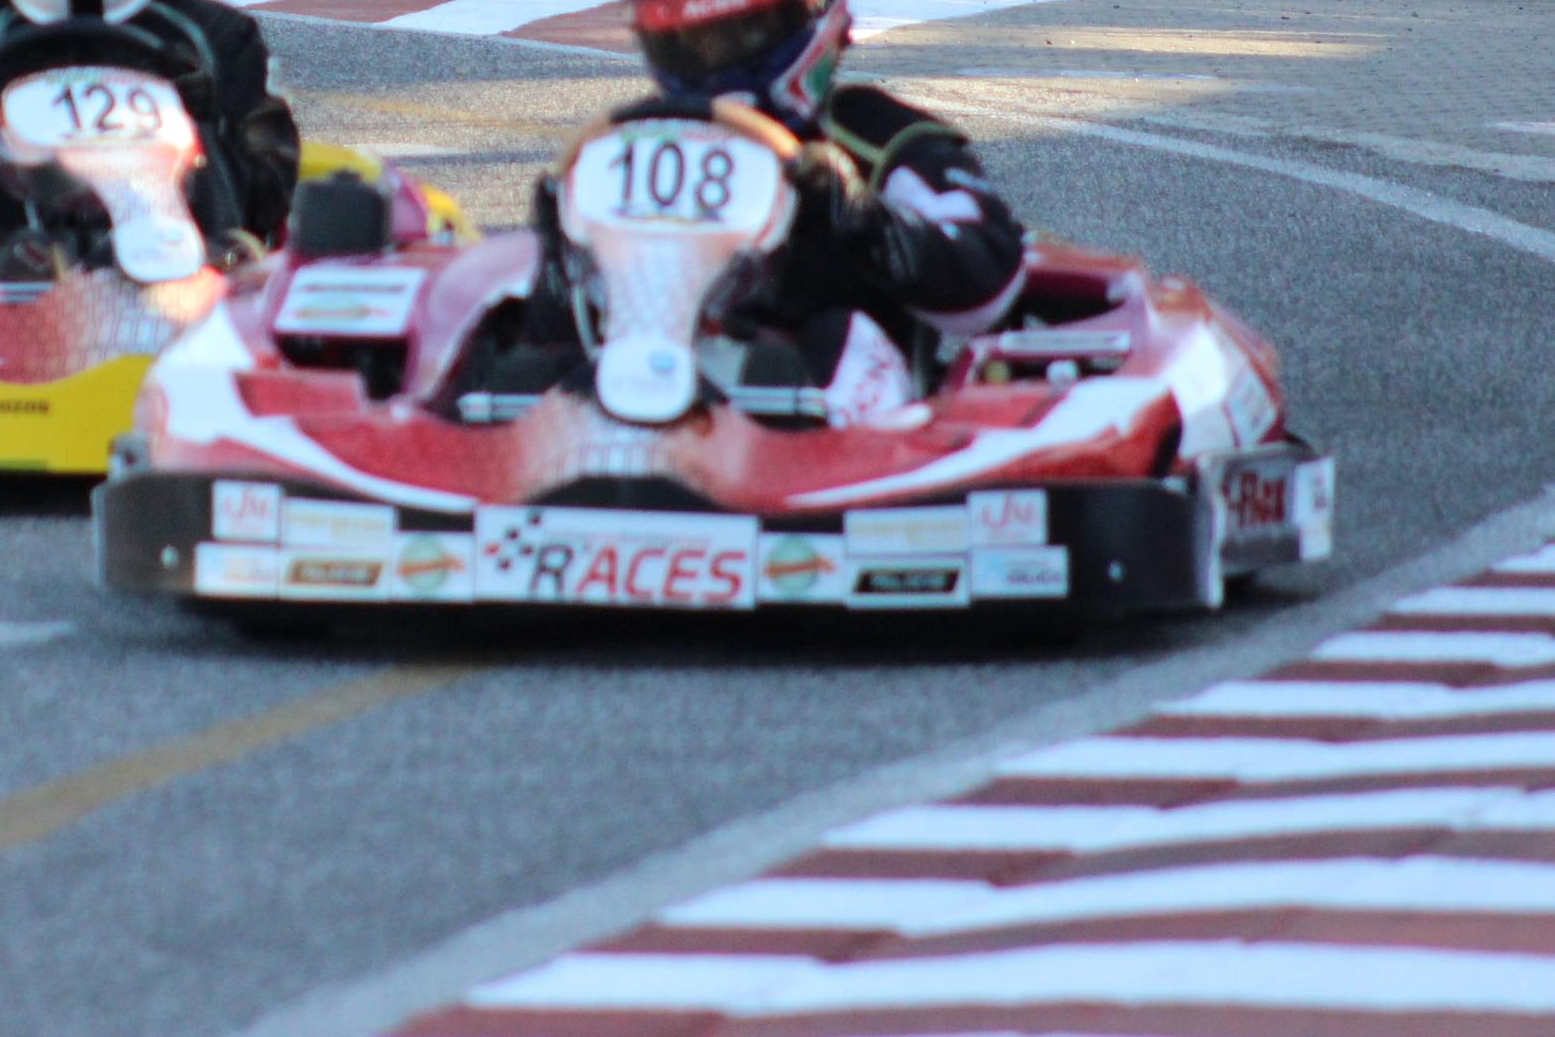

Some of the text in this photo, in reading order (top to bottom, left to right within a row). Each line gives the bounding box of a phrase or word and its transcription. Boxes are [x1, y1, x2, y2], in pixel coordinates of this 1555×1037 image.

[51, 83, 163, 133] 129
[608, 141, 734, 210] 108
[529, 543, 747, 606] RACES
